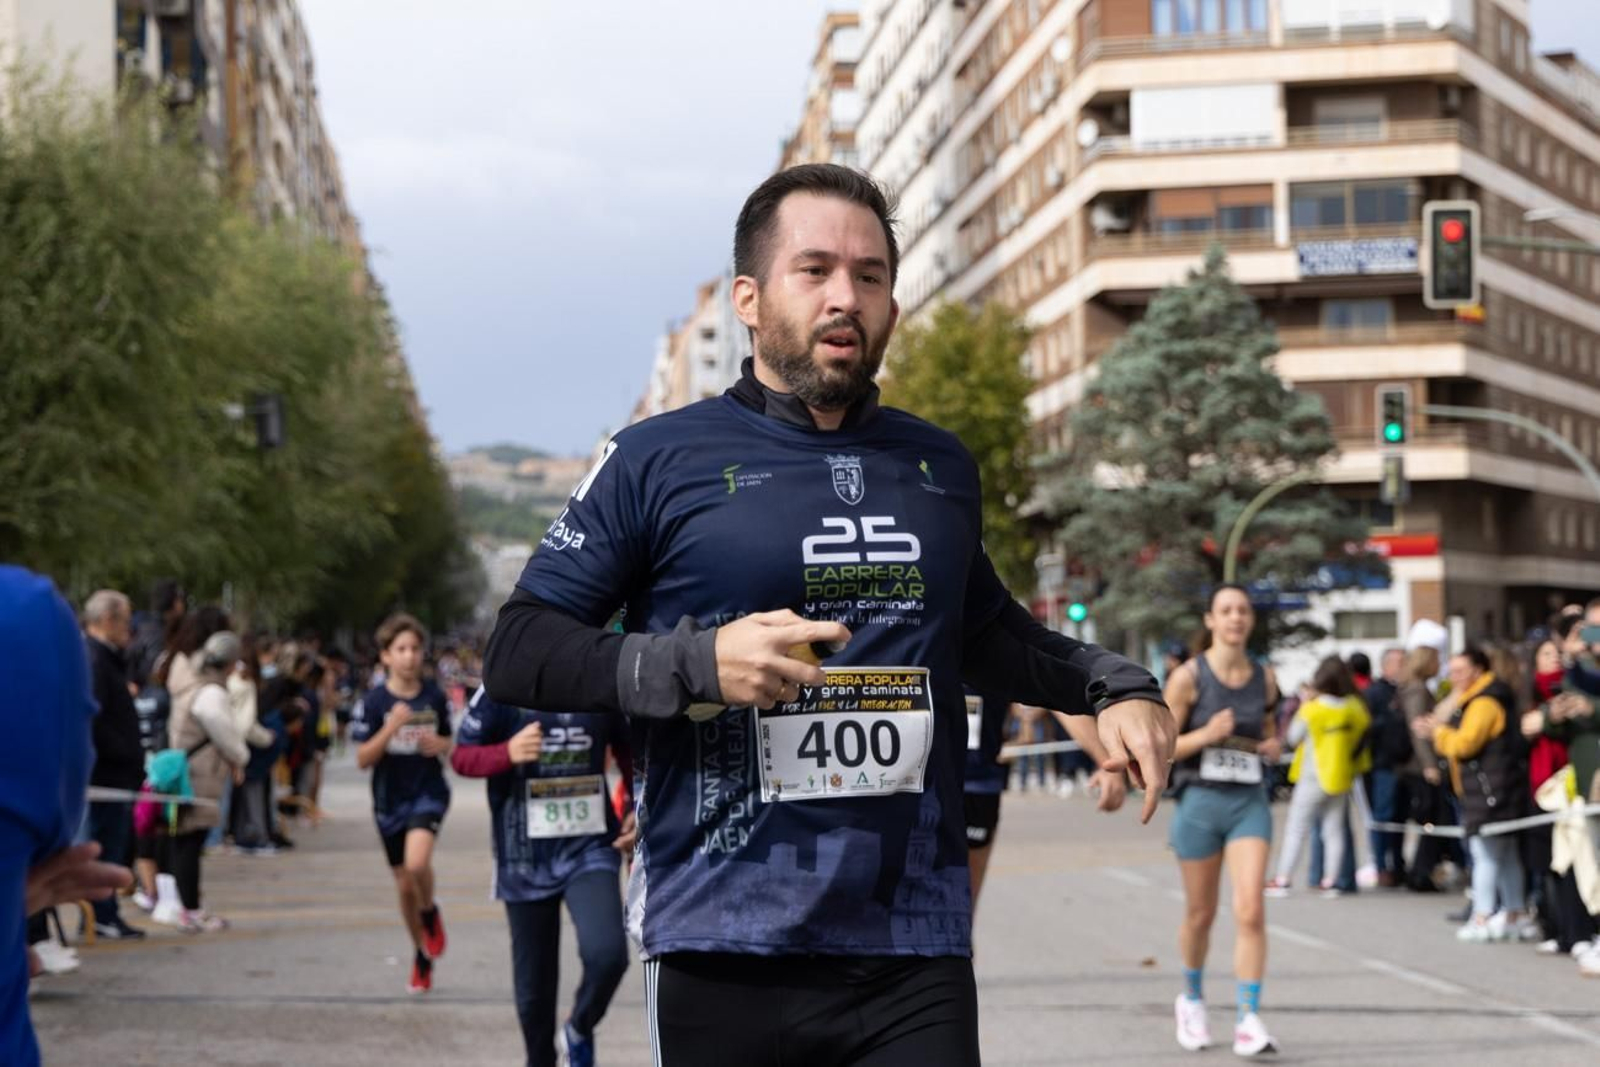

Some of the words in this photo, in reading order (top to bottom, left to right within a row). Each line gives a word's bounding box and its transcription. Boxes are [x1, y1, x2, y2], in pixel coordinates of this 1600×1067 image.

[802, 516, 921, 565] 25
[804, 565, 923, 582] CARRERA
[806, 582, 925, 599] POPULAR
[805, 601, 815, 612] y
[819, 600, 852, 611] gran
[857, 599, 925, 611] caminata
[804, 688, 813, 699] y
[821, 685, 855, 698] gran
[862, 684, 923, 696] caminata
[541, 726, 593, 752] 25
[797, 719, 901, 768] 400
[701, 750, 721, 822] SANTA
[545, 800, 589, 823] 813
